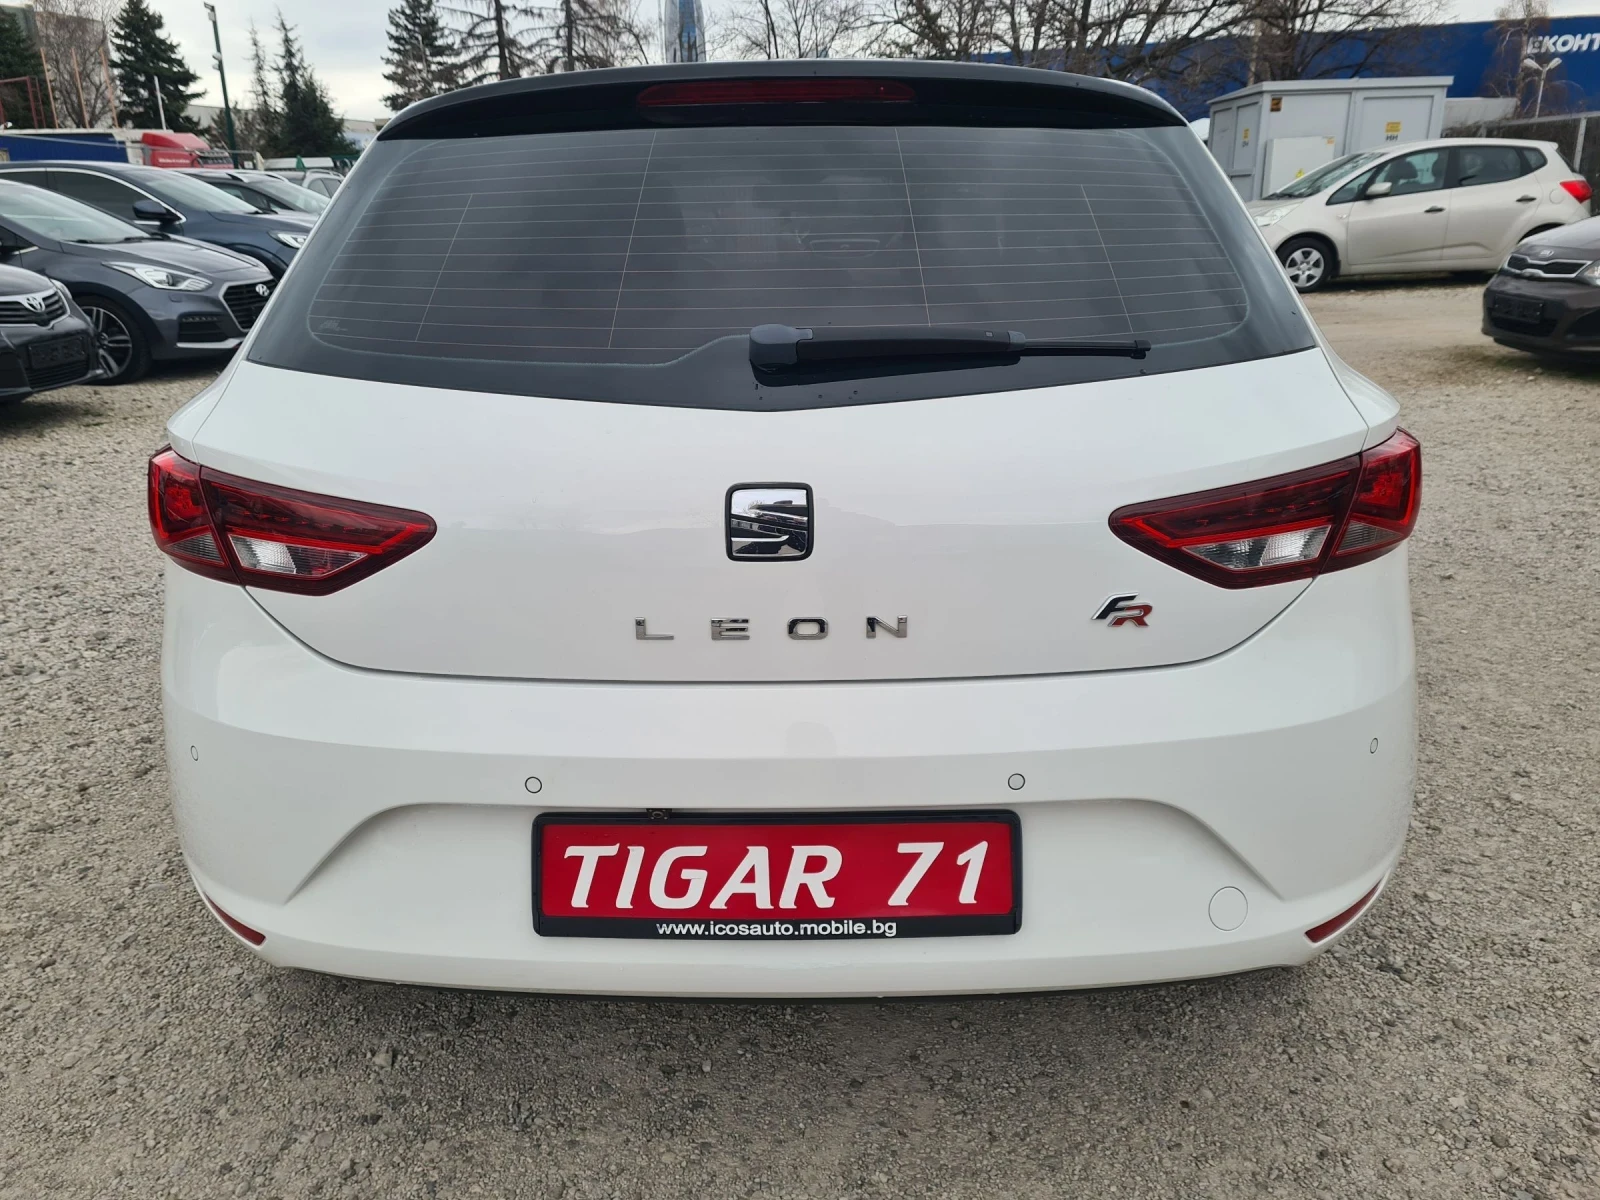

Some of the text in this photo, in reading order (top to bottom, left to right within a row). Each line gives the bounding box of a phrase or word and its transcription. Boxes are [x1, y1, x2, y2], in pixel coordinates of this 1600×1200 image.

[1091, 592, 1153, 627] FR
[635, 615, 908, 641] LEON
[563, 840, 989, 910] TIGAR 71
[656, 920, 898, 937] www.icosauto.mobile.bg
